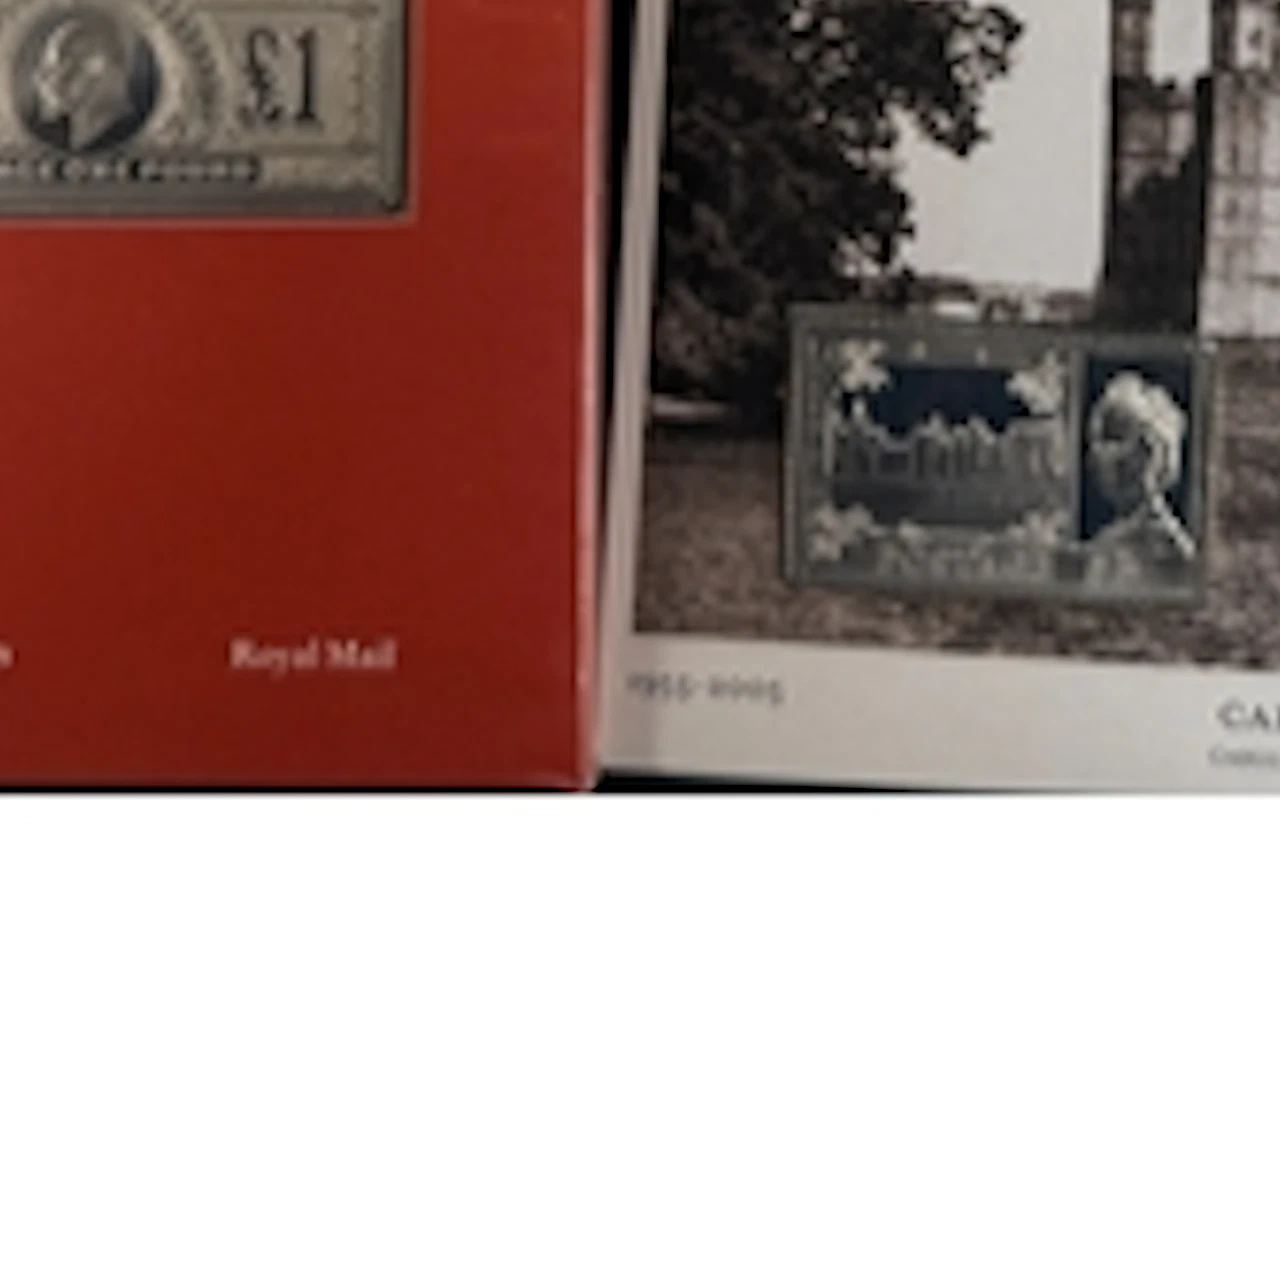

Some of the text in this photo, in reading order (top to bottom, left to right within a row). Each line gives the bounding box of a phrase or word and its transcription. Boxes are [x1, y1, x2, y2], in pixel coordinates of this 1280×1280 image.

[238, 27, 326, 130] £1
[229, 634, 400, 681] Royal Mail
